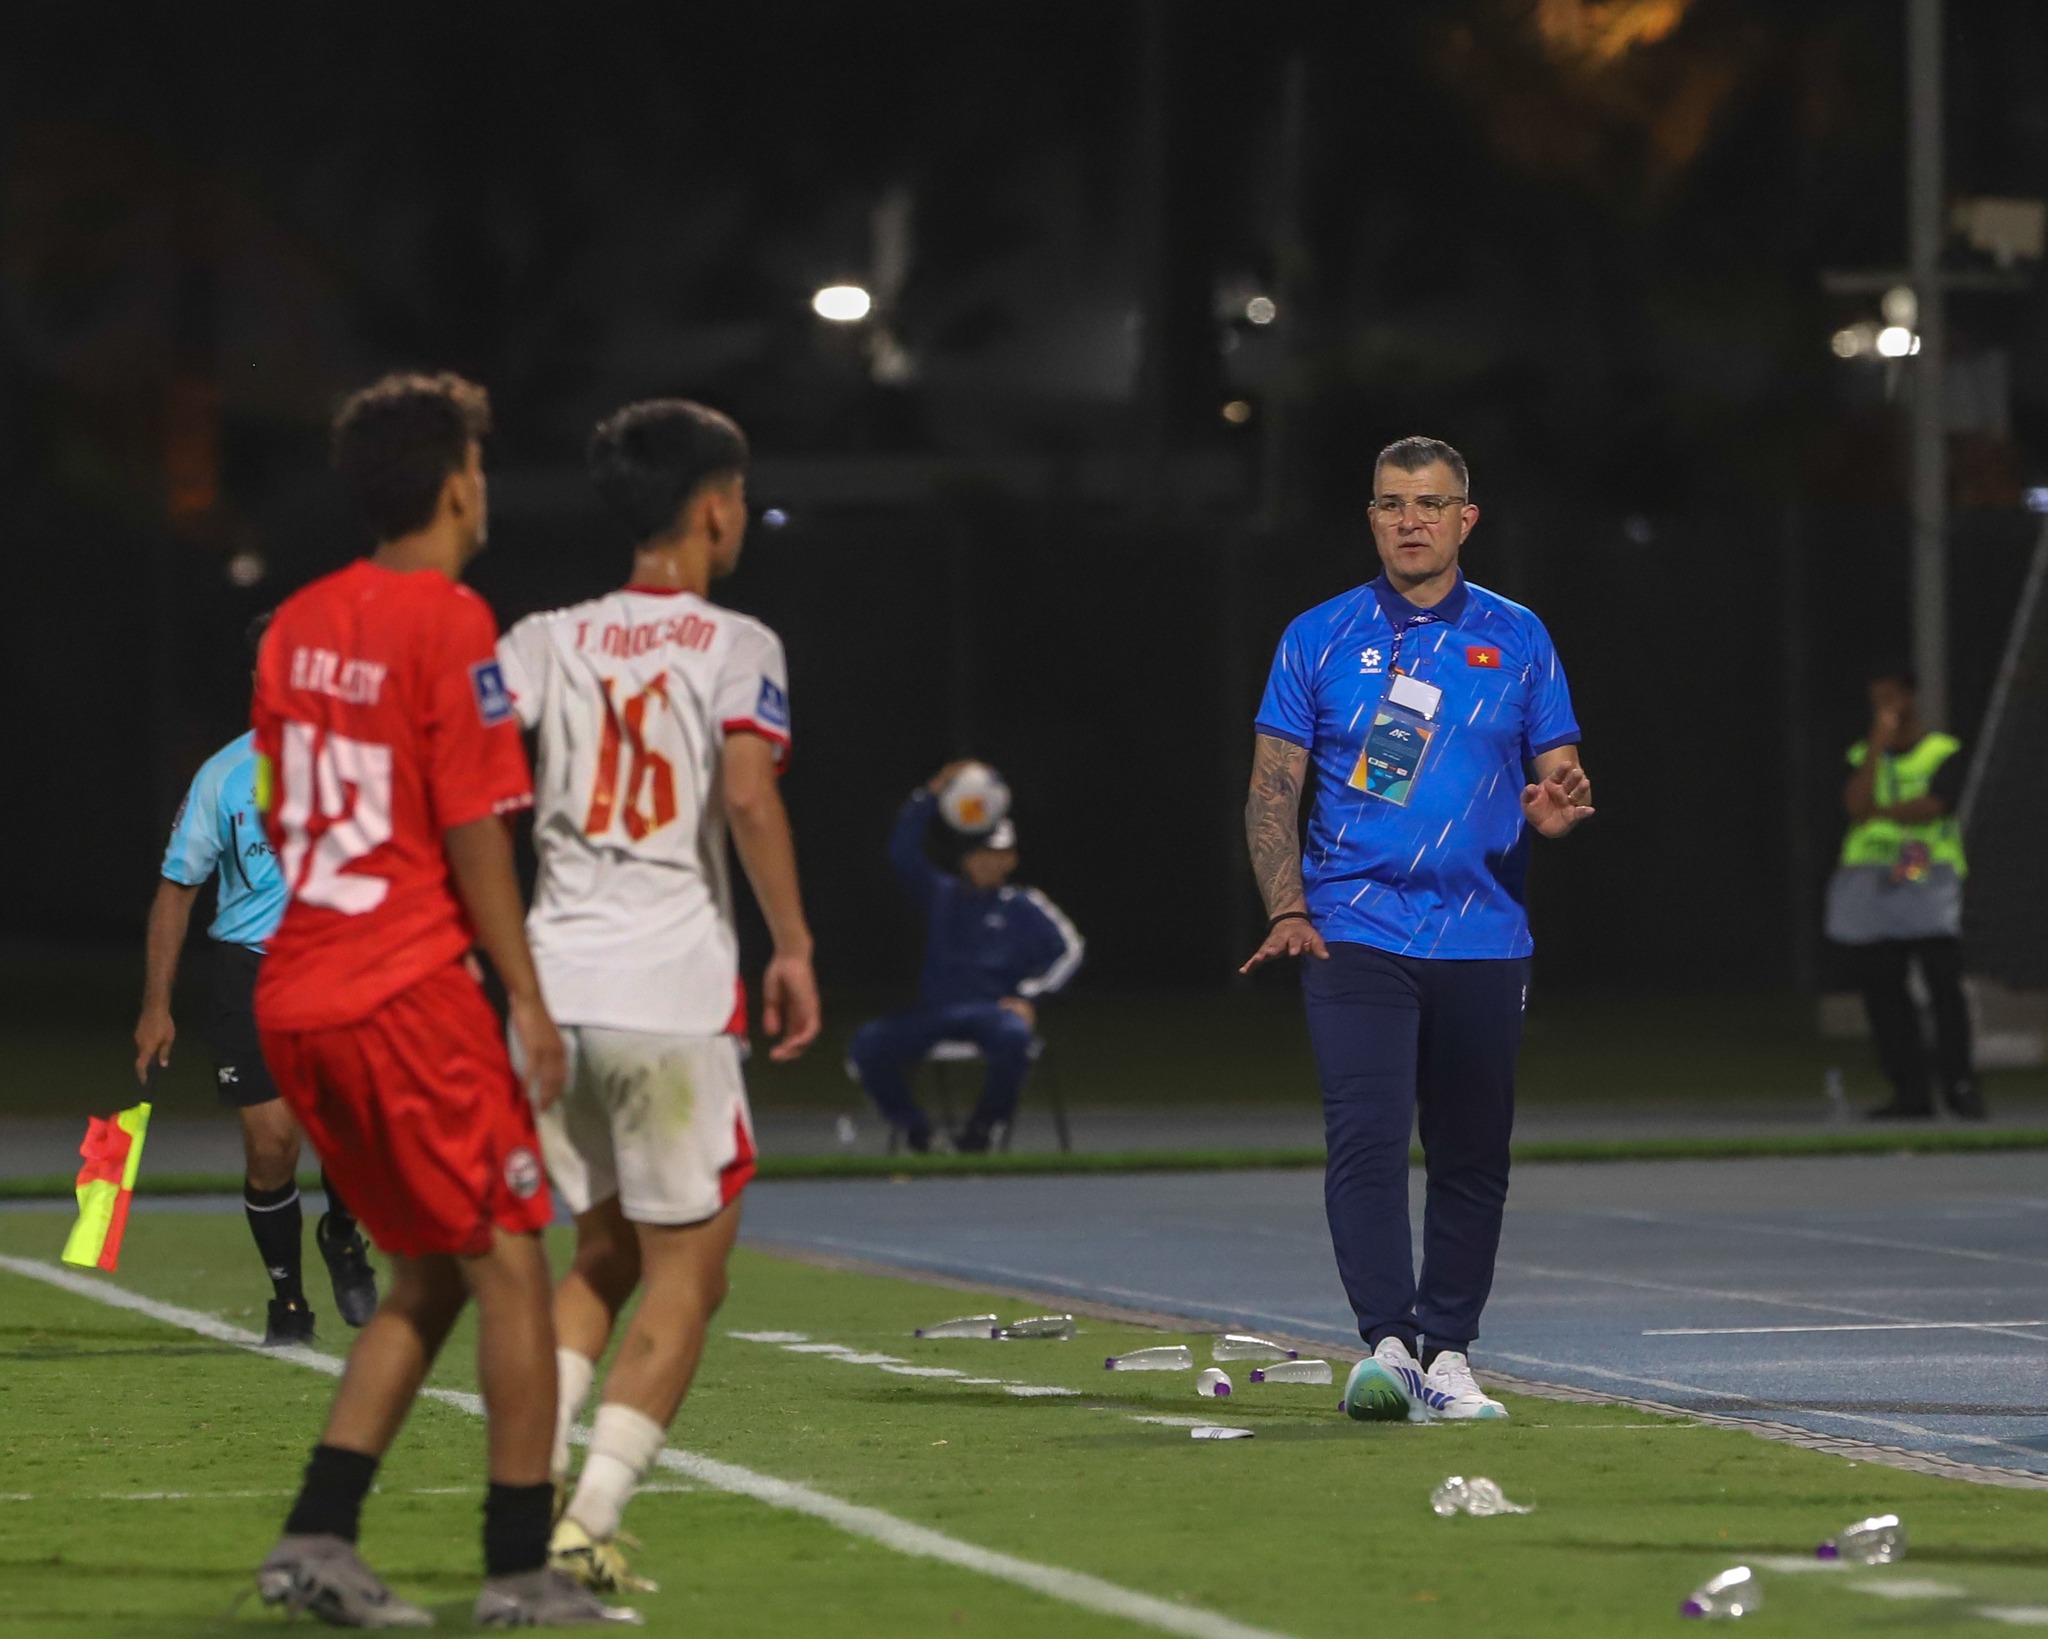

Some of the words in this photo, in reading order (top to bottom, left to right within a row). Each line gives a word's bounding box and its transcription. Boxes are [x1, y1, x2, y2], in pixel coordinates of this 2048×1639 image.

[279, 720, 394, 917] 12
[584, 667, 678, 842] 16
[1389, 728, 1412, 742] AFC
